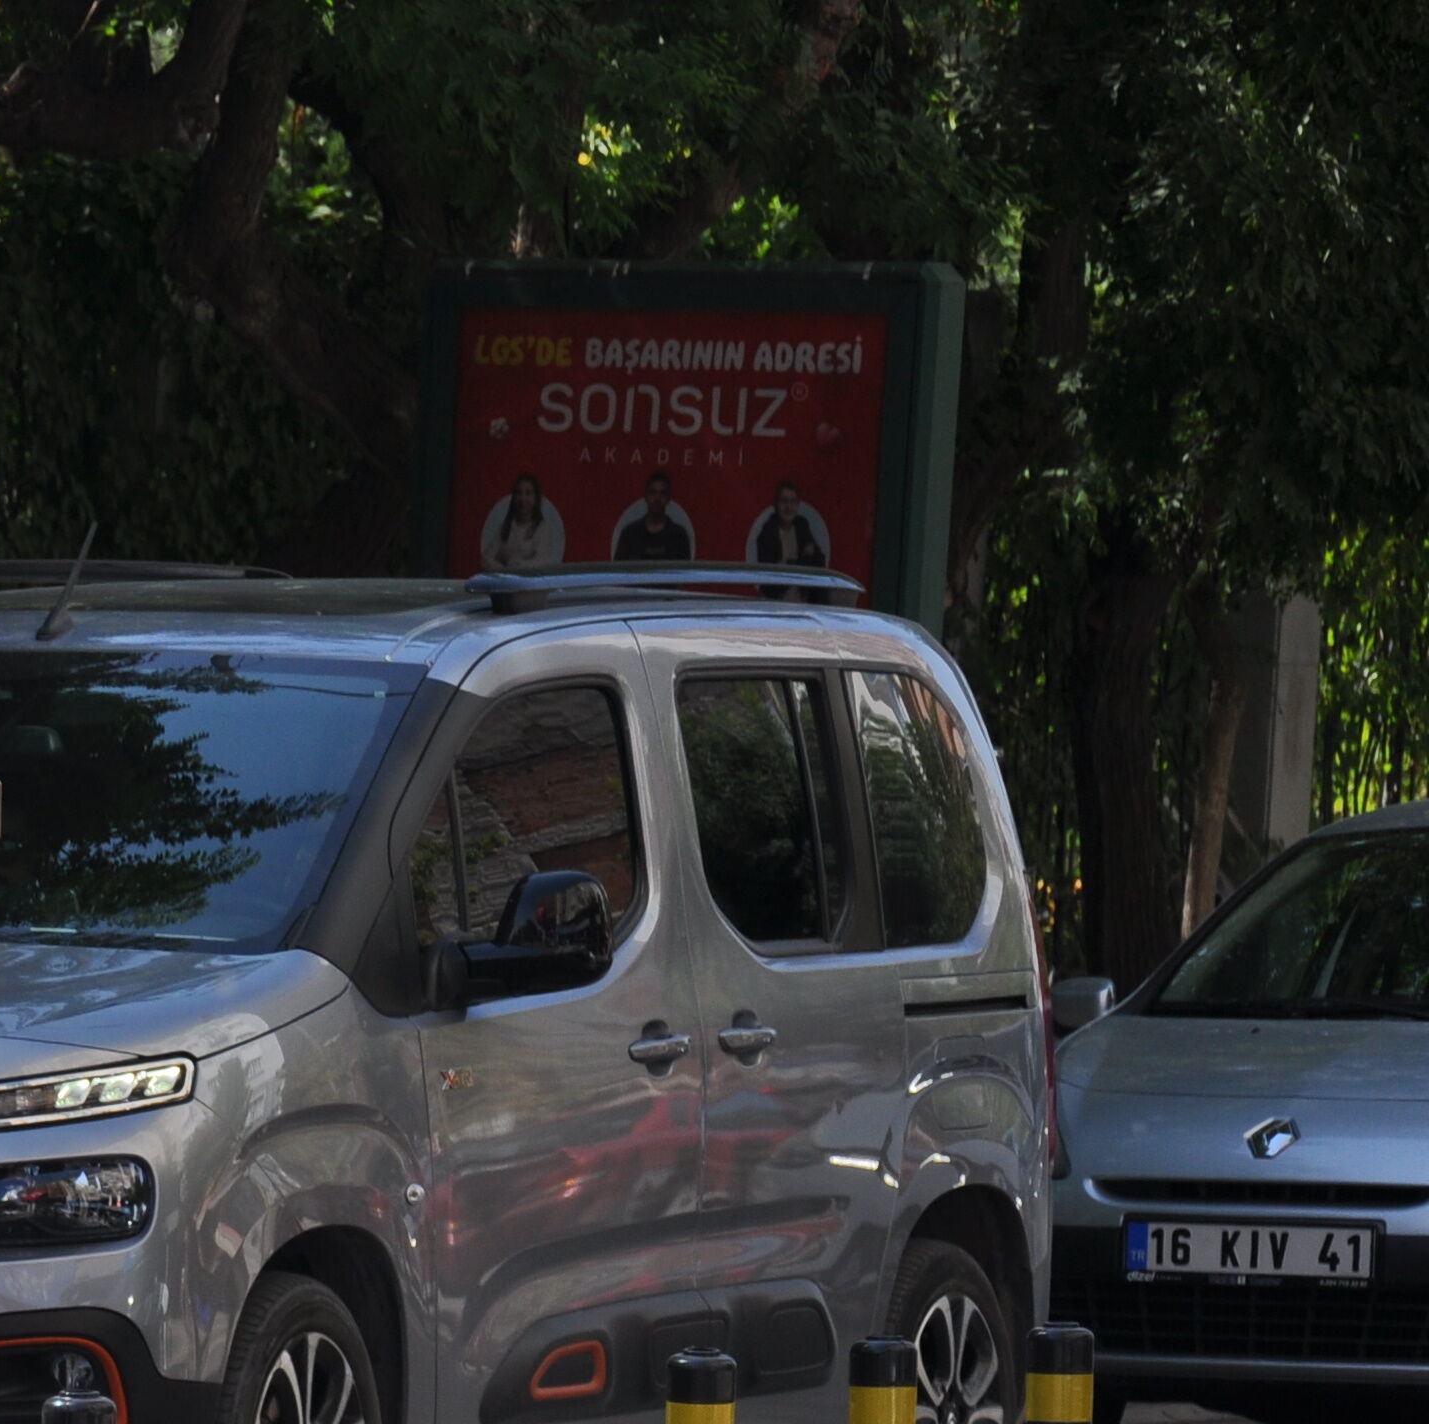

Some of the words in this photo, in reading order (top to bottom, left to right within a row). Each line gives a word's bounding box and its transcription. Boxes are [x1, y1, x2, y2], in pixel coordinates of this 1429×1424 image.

[474, 335, 572, 368] LGS'DE
[584, 336, 744, 375] BAŞARININ
[754, 335, 862, 374] ADRESİ
[1151, 1228, 1191, 1266] 16
[1220, 1230, 1289, 1270] KIV
[1318, 1233, 1361, 1272] 41
